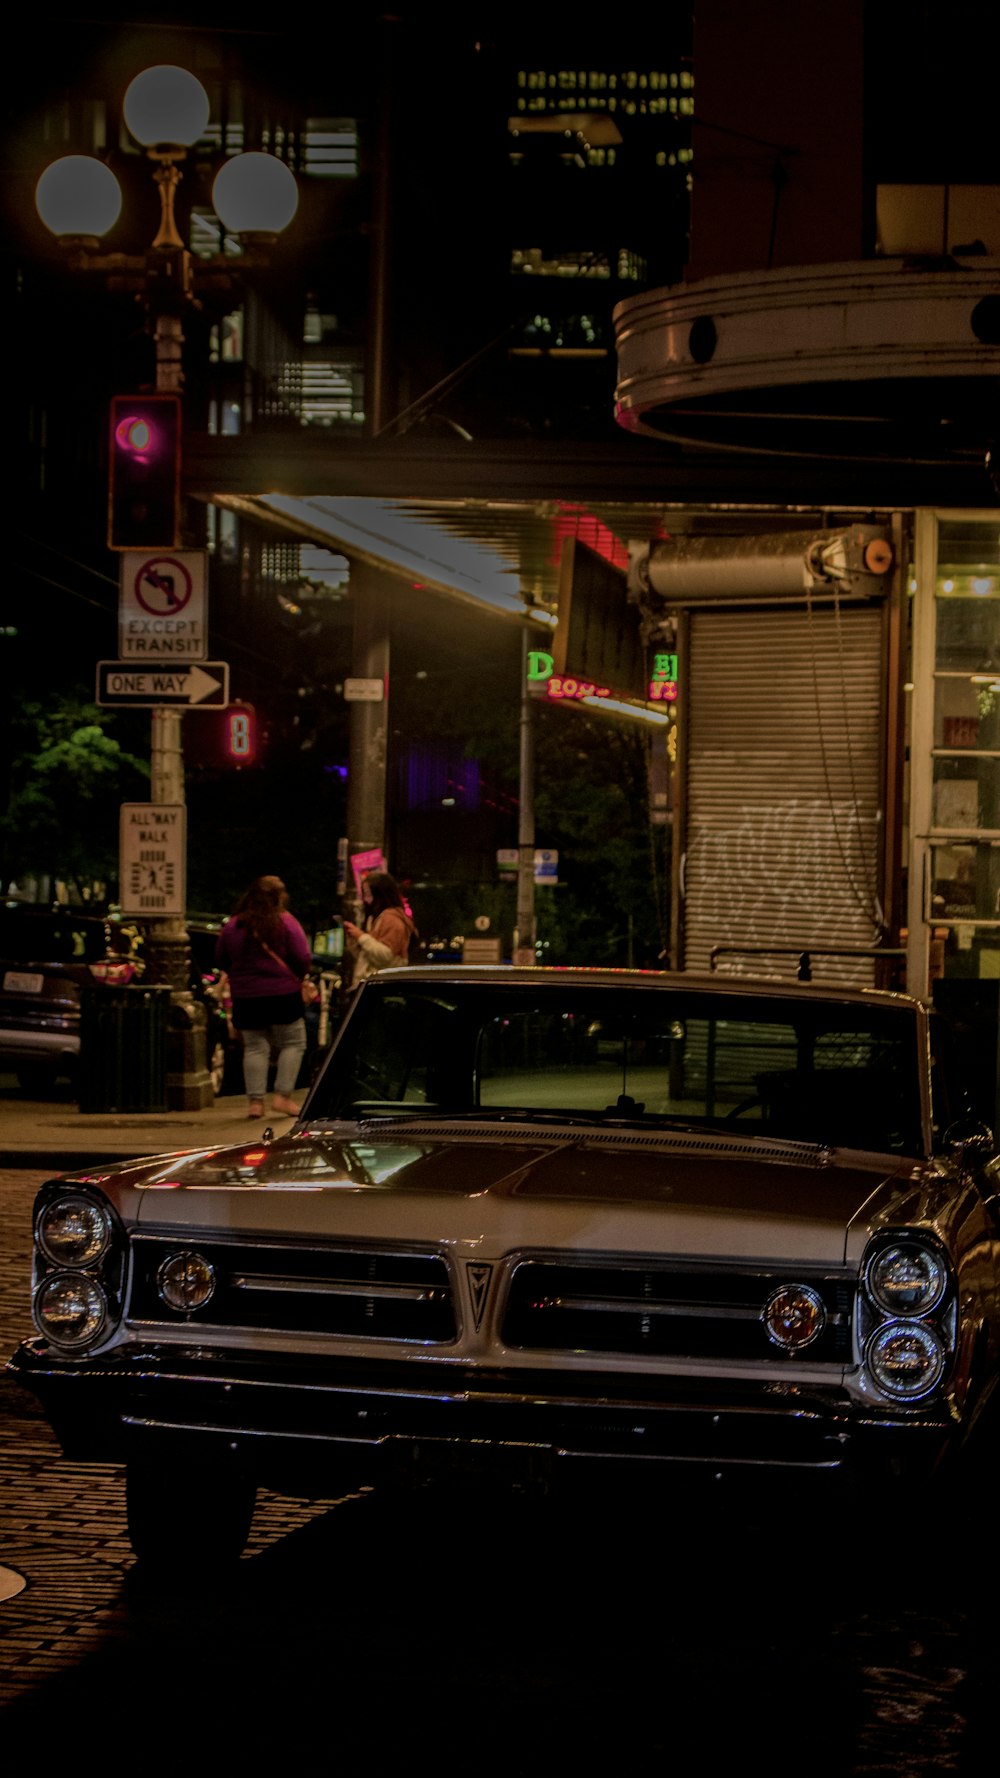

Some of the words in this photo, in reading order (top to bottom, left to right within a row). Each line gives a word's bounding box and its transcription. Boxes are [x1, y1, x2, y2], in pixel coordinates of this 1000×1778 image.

[128, 620, 198, 634] EXCEPT
[126, 638, 201, 652] TRANSIT
[111, 676, 145, 692] ONE
[153, 676, 188, 692] WAY
[230, 714, 249, 755] 8
[130, 813, 150, 825] ALL
[154, 813, 177, 825] WAY
[139, 830, 168, 843] WALK
